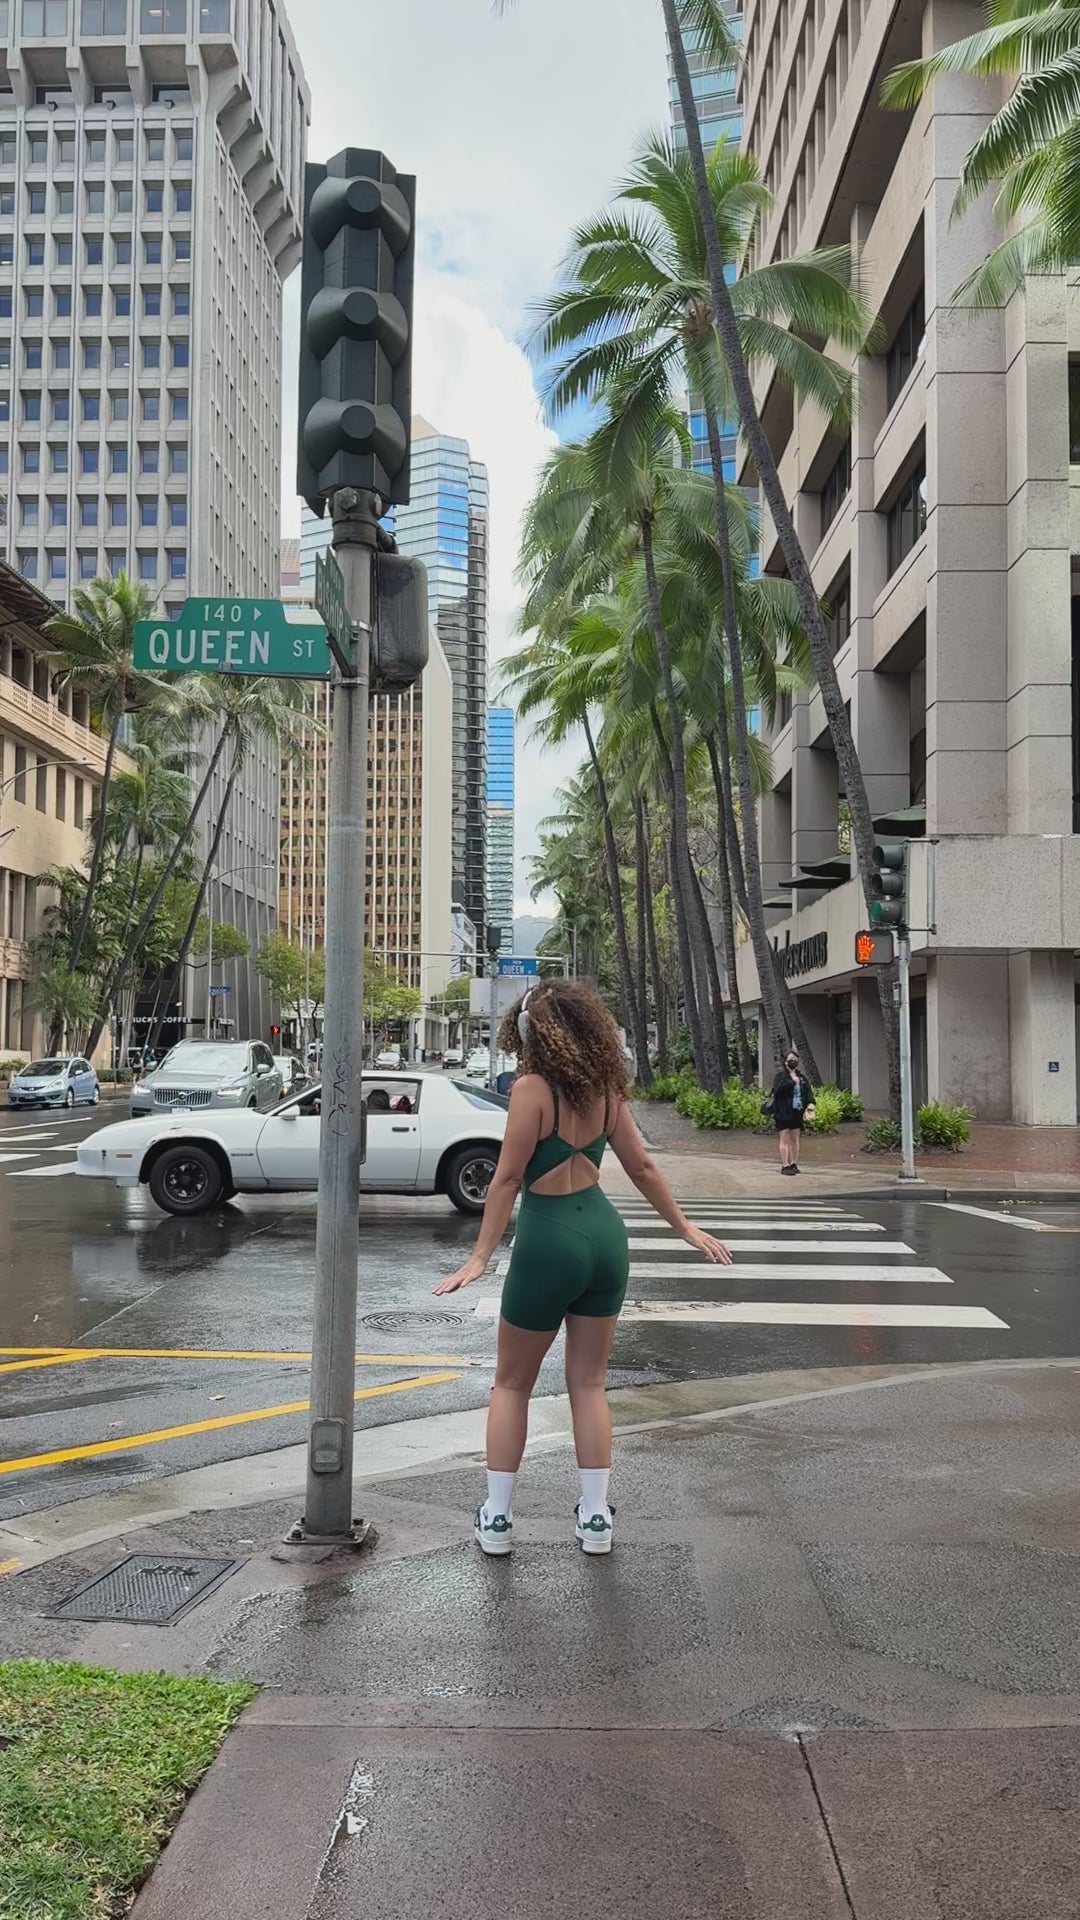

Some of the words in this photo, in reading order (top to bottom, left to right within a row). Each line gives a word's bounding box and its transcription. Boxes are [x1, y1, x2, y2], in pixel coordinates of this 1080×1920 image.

[203, 604, 242, 622] 140
[318, 566, 344, 642] BISHOP
[149, 629, 270, 664] QUEEN
[292, 639, 315, 657] ST
[503, 965, 525, 974] QUEEN
